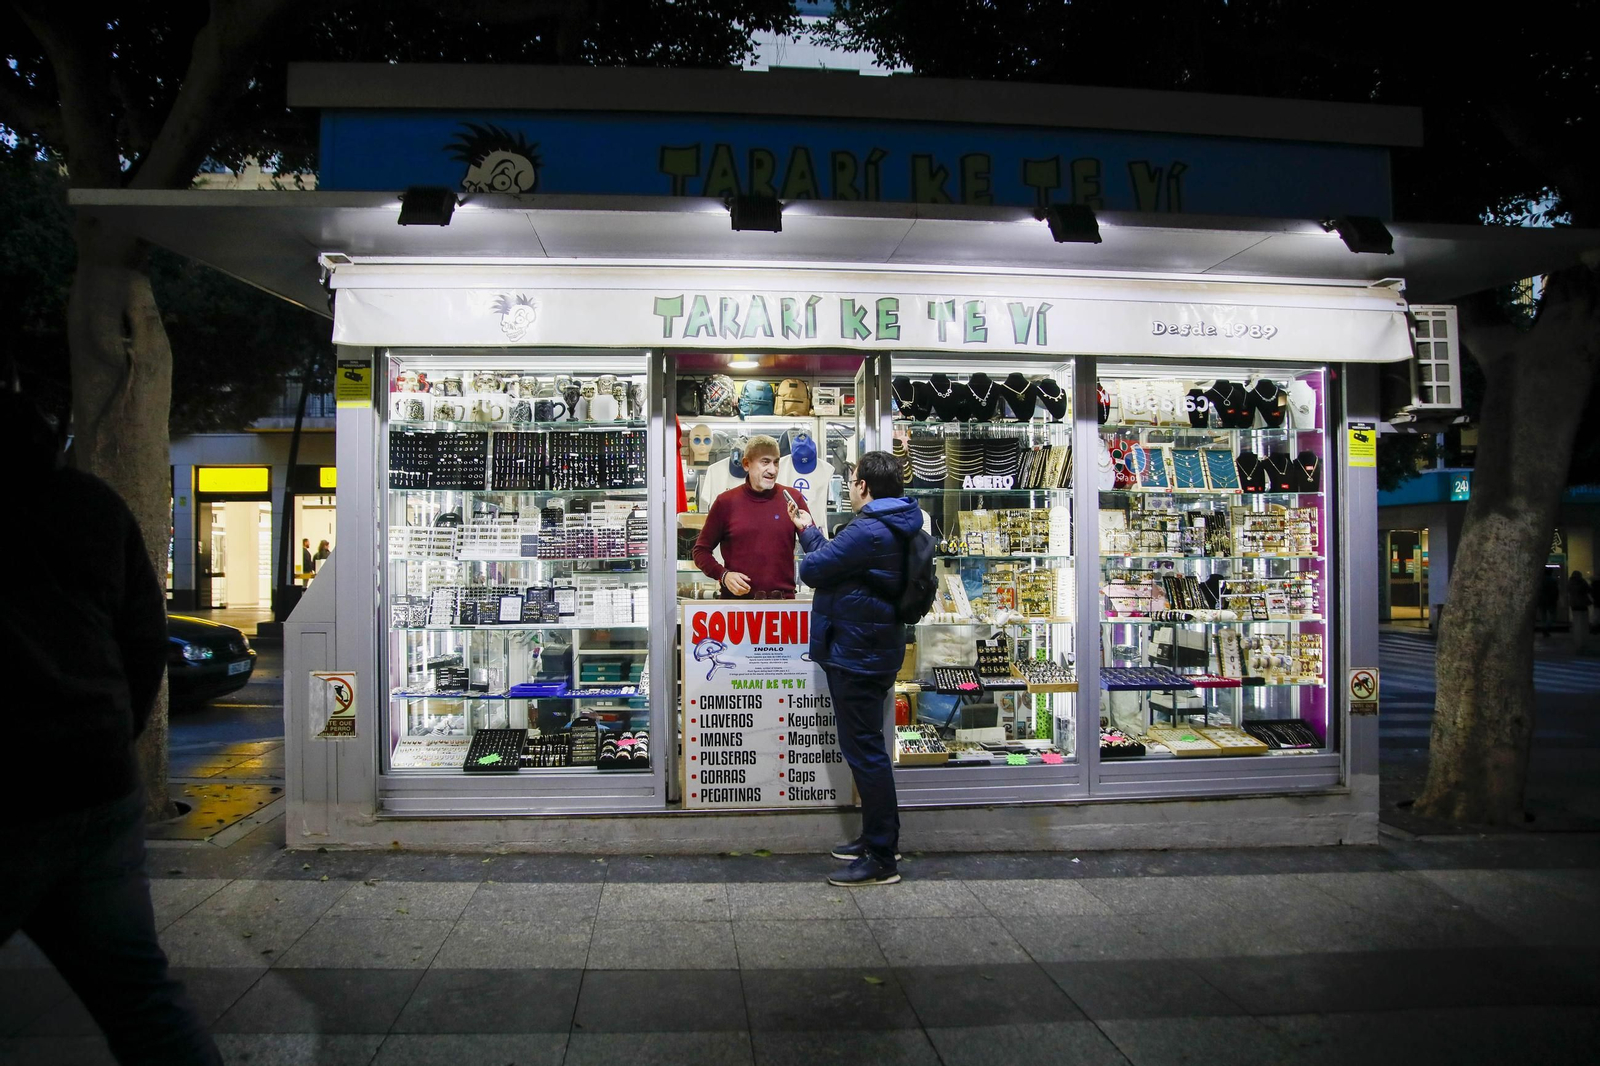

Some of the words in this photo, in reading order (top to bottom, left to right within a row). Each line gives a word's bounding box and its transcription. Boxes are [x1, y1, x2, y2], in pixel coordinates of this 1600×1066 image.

[660, 143, 889, 201] TARARÍ
[911, 153, 994, 206] KE
[1022, 155, 1103, 210] TE
[653, 293, 823, 341] TARARÍ
[840, 296, 901, 342] KE
[927, 298, 988, 345] TE
[1007, 301, 1054, 347] VÍ
[1151, 320, 1218, 338] Desde
[1223, 321, 1278, 340] 1989
[962, 474, 1014, 490] ACERO
[700, 694, 762, 710] CAMISETAS
[787, 694, 831, 708] T-shirts
[700, 713, 753, 729] LLAVEROS
[700, 732, 743, 747] IMANES
[788, 731, 836, 748] Magnets
[700, 750, 756, 766] PULSERAS
[788, 749, 842, 764] Bracelets
[700, 769, 746, 785] GORRAS
[788, 768, 816, 785] Caps
[700, 787, 761, 803] PEGATINAS
[788, 786, 836, 801] Stickers
